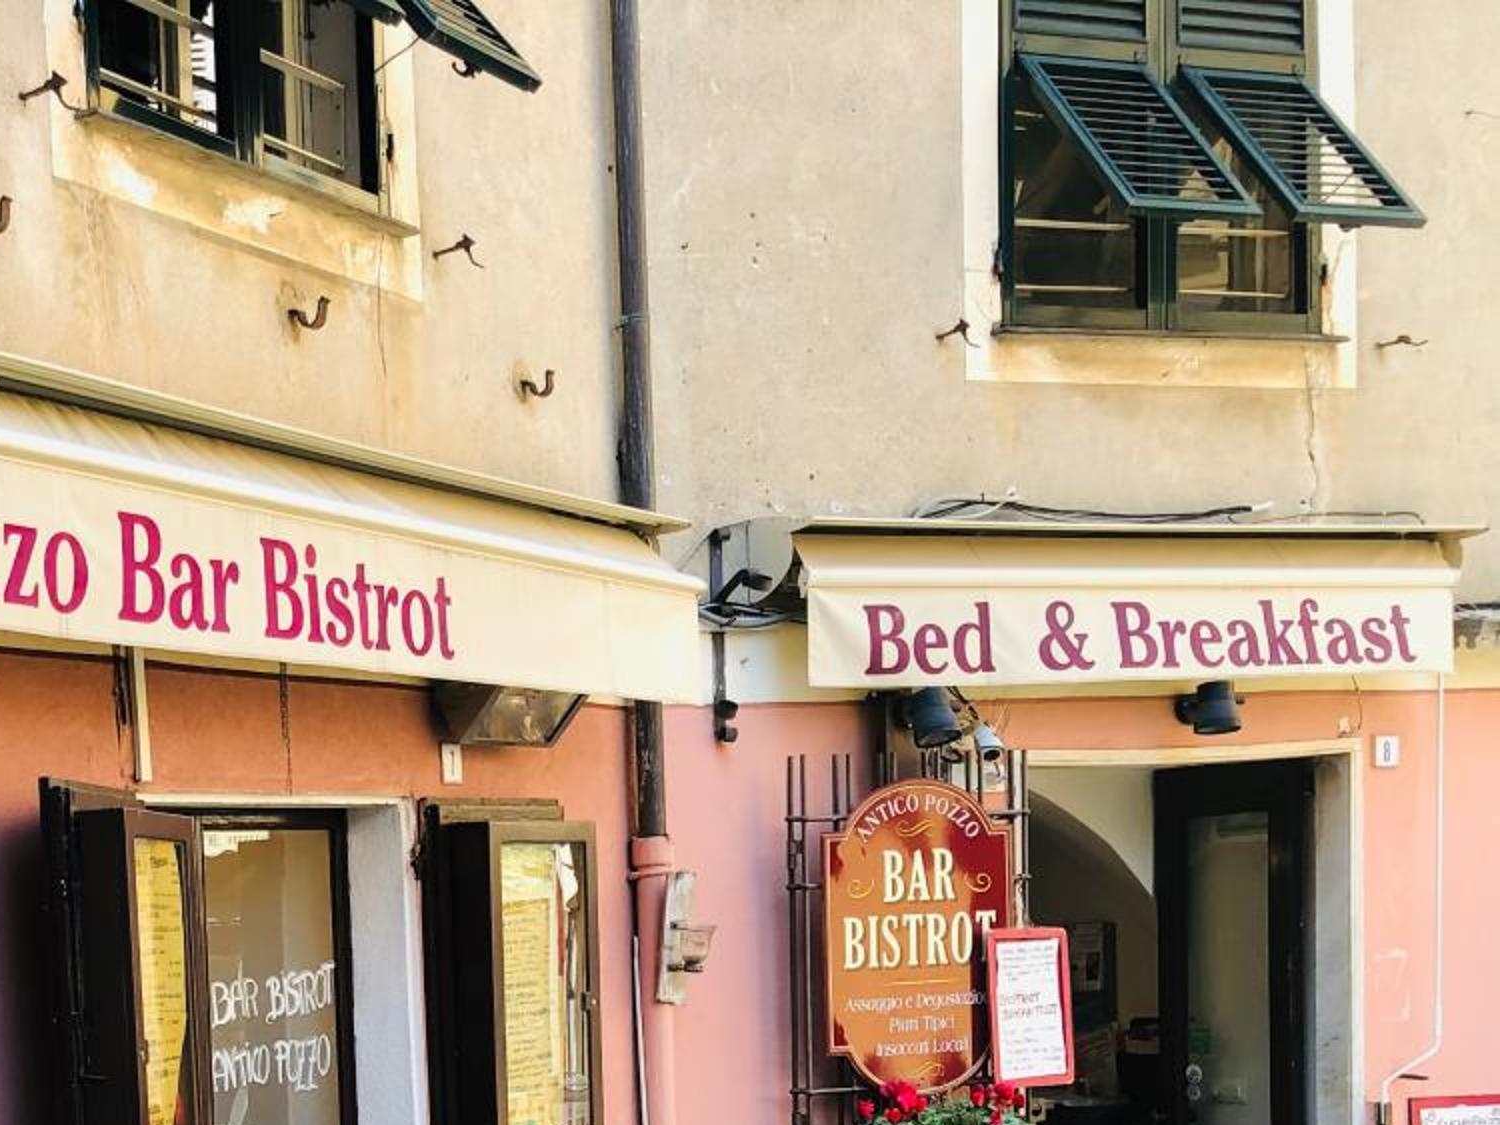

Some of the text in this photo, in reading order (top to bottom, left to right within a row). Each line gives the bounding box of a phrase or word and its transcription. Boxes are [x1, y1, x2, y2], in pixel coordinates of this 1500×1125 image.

[116, 511, 240, 634] Bar
[259, 537, 455, 662] Bistrot
[864, 598, 1418, 676] Bed & Breakfast
[1382, 738, 1392, 762] 8
[856, 793, 981, 844] ANTICO POZZO
[882, 847, 956, 903] BAR
[843, 909, 997, 970] BISTROT
[211, 961, 259, 1028] BAR
[274, 1033, 331, 1091] POZZO
